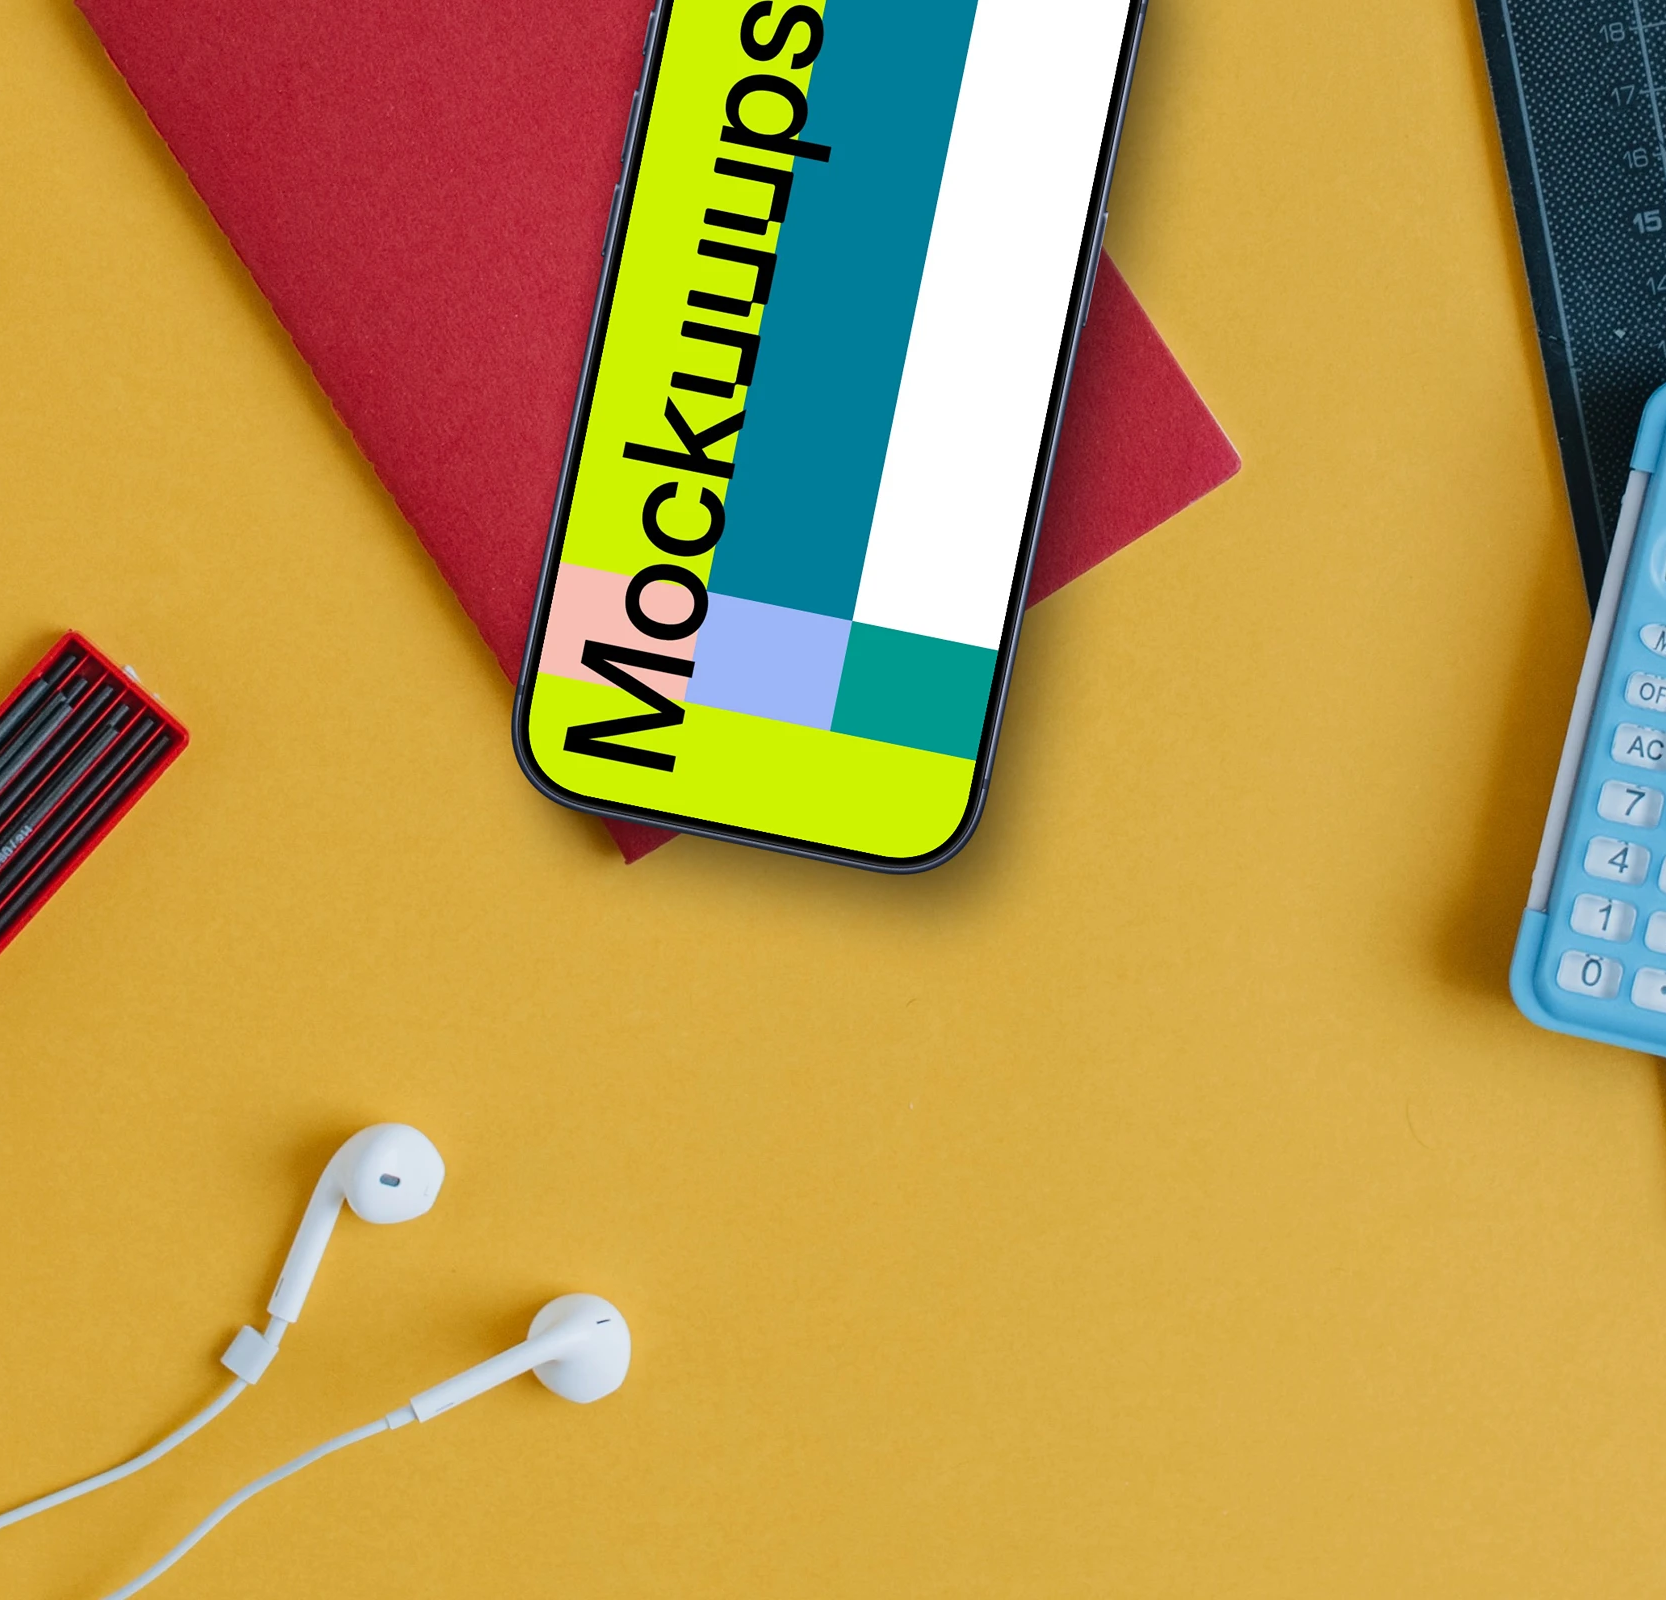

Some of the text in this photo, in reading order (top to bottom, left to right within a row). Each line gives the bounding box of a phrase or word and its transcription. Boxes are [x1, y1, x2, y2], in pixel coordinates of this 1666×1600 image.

[1600, 22, 1625, 44] 18
[1611, 85, 1635, 107] 17
[1623, 148, 1649, 170] 16
[1633, 210, 1663, 233] 15
[1626, 736, 1665, 761] AC
[1625, 790, 1645, 817] 7
[1607, 848, 1630, 873] 4
[1598, 903, 1611, 930] 1
[1580, 958, 1602, 986] 0
